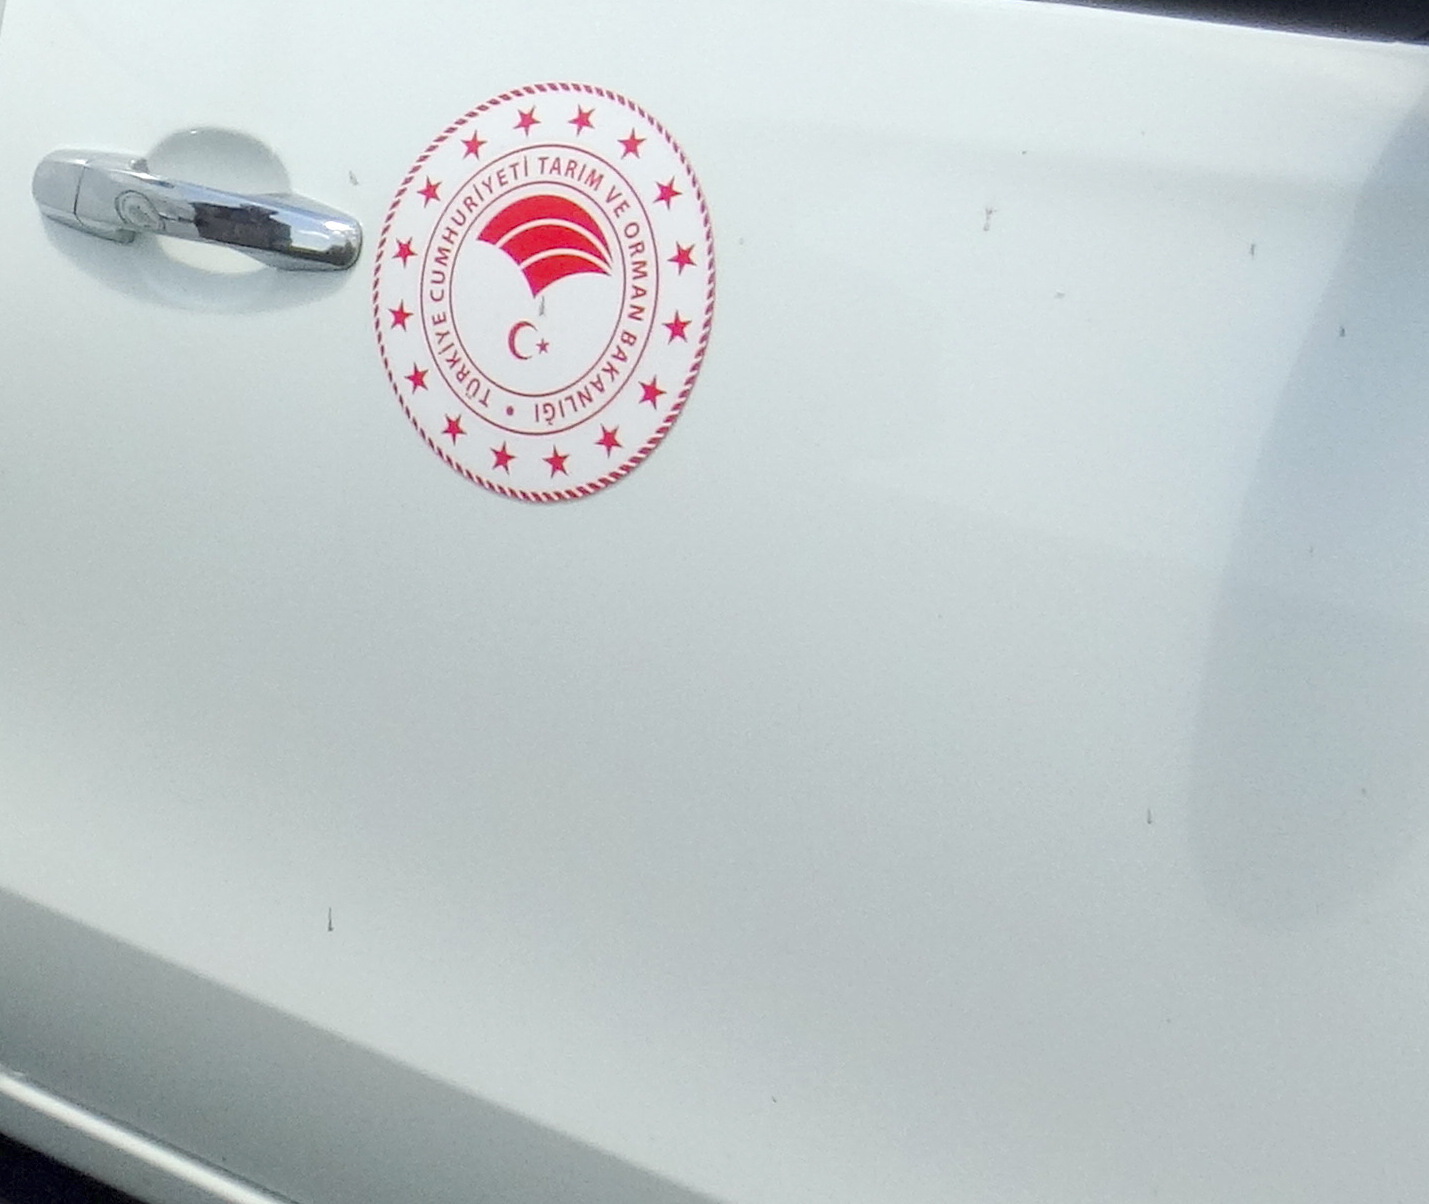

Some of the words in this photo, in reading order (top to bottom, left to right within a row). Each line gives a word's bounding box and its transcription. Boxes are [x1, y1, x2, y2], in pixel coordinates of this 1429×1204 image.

[538, 155, 604, 192] TARIM
[605, 184, 631, 219] VE
[429, 155, 529, 303] CUMHURİYETİ
[623, 220, 648, 323] ORMAN
[431, 311, 492, 409] TÜRKİYE
[533, 332, 637, 426] BAKANLIĞI
